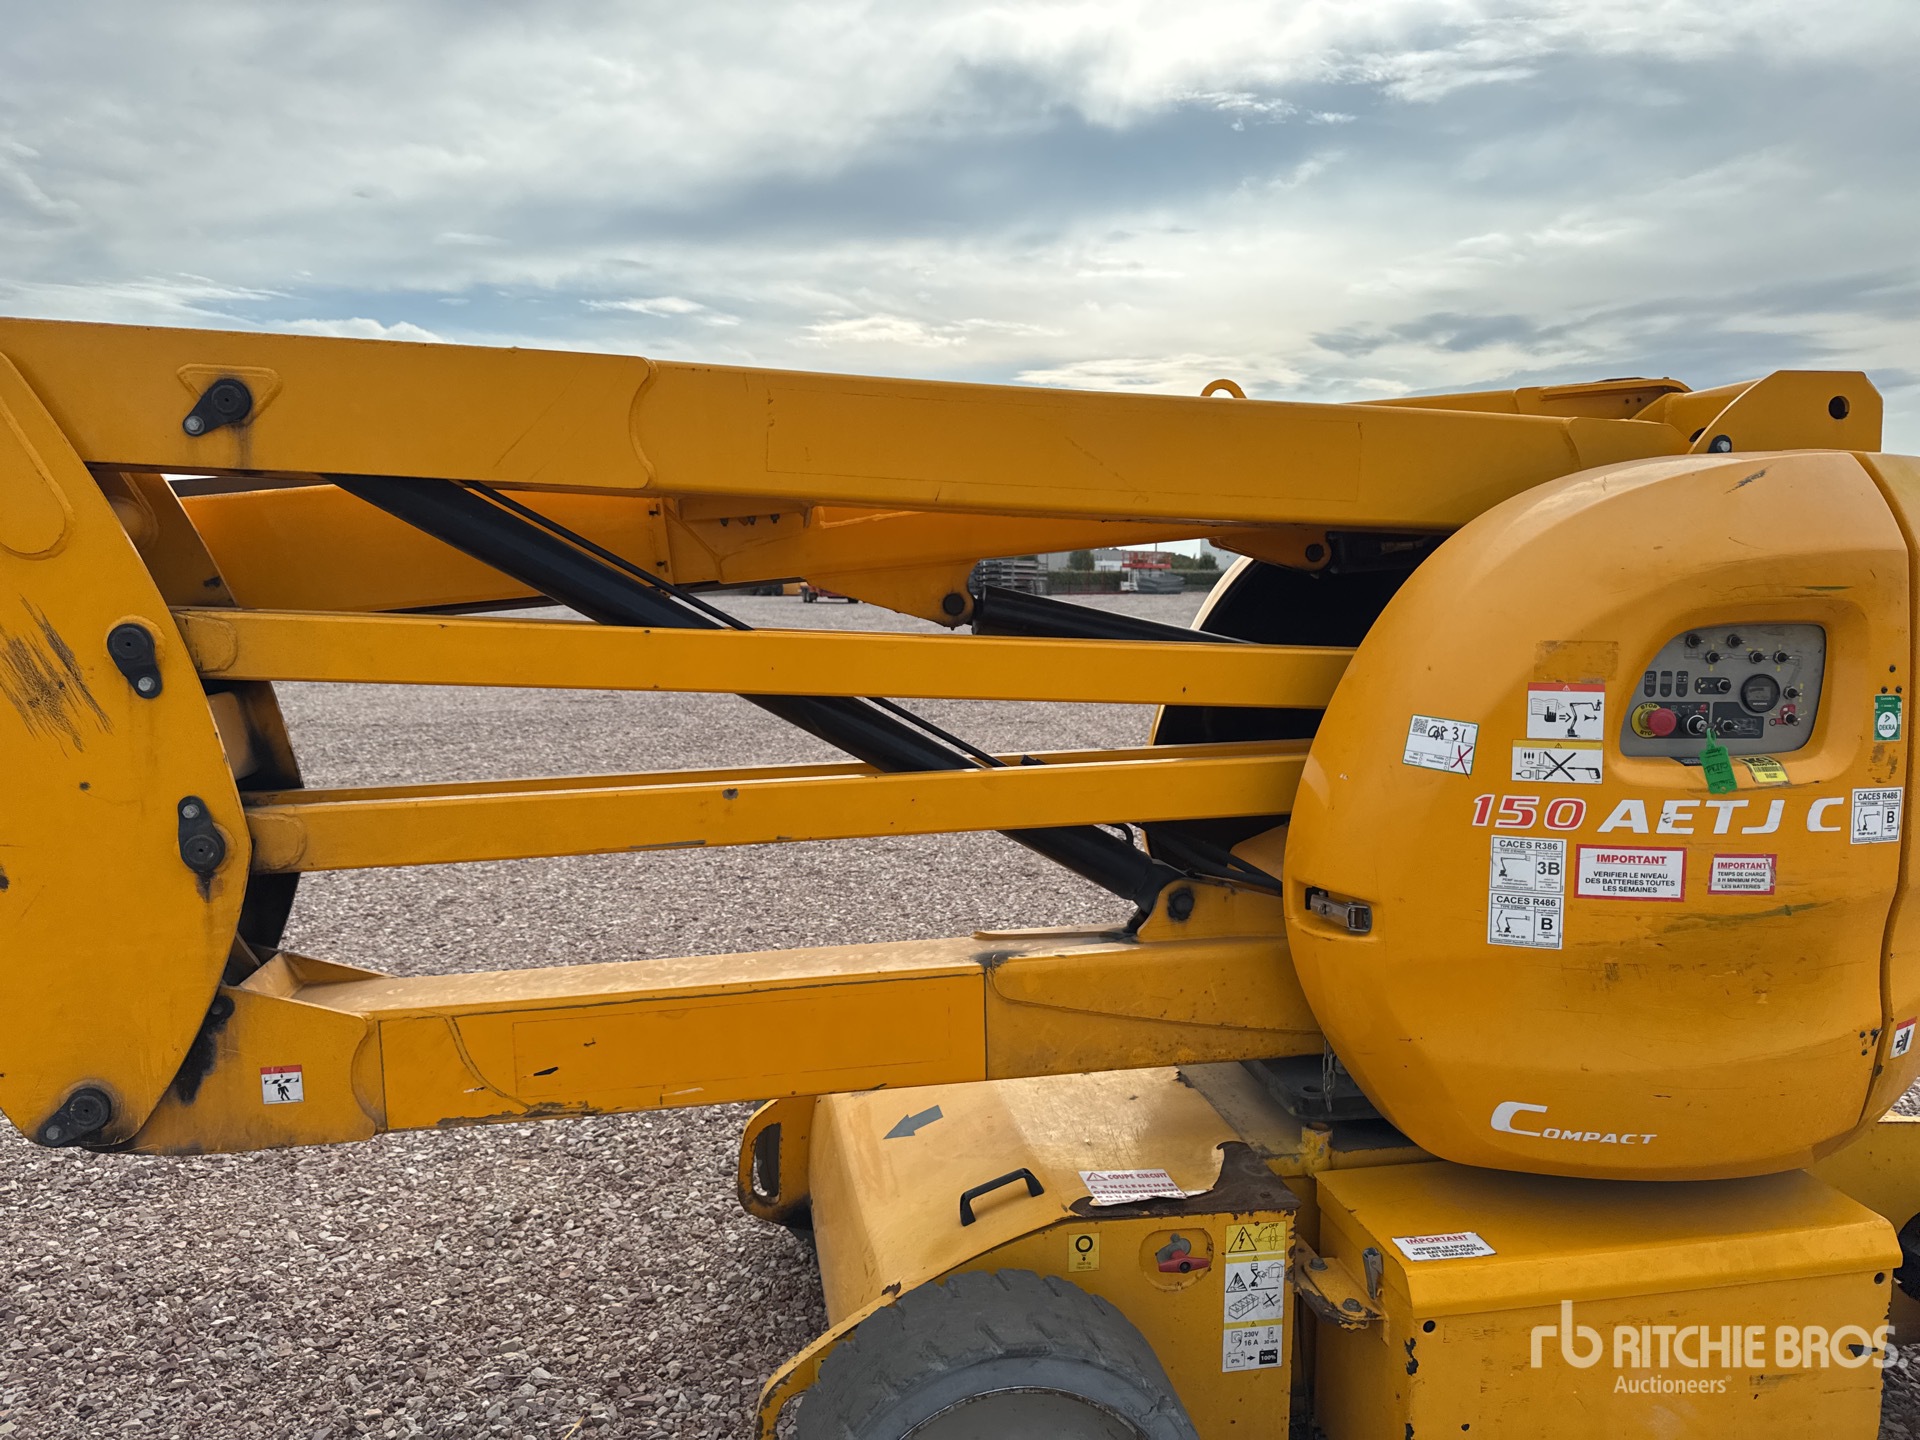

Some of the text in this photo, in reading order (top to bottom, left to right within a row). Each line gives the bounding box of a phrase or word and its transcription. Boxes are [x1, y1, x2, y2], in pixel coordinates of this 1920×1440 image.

[1857, 791, 1898, 801] CACES R486
[1472, 794, 1845, 835] 150 AETJ C
[1886, 810, 1895, 824] B
[1499, 839, 1558, 850] CACES R386
[1596, 854, 1667, 865] IMPORTANT
[1537, 861, 1560, 876] 3B
[1593, 871, 1628, 879] VERIFIER
[1602, 878, 1644, 886] BATTERIES
[1496, 895, 1556, 907] CACES R486
[1541, 917, 1553, 931] B
[1490, 1101, 1658, 1145] COMPACT
[1405, 1234, 1469, 1245] IMPORTANT
